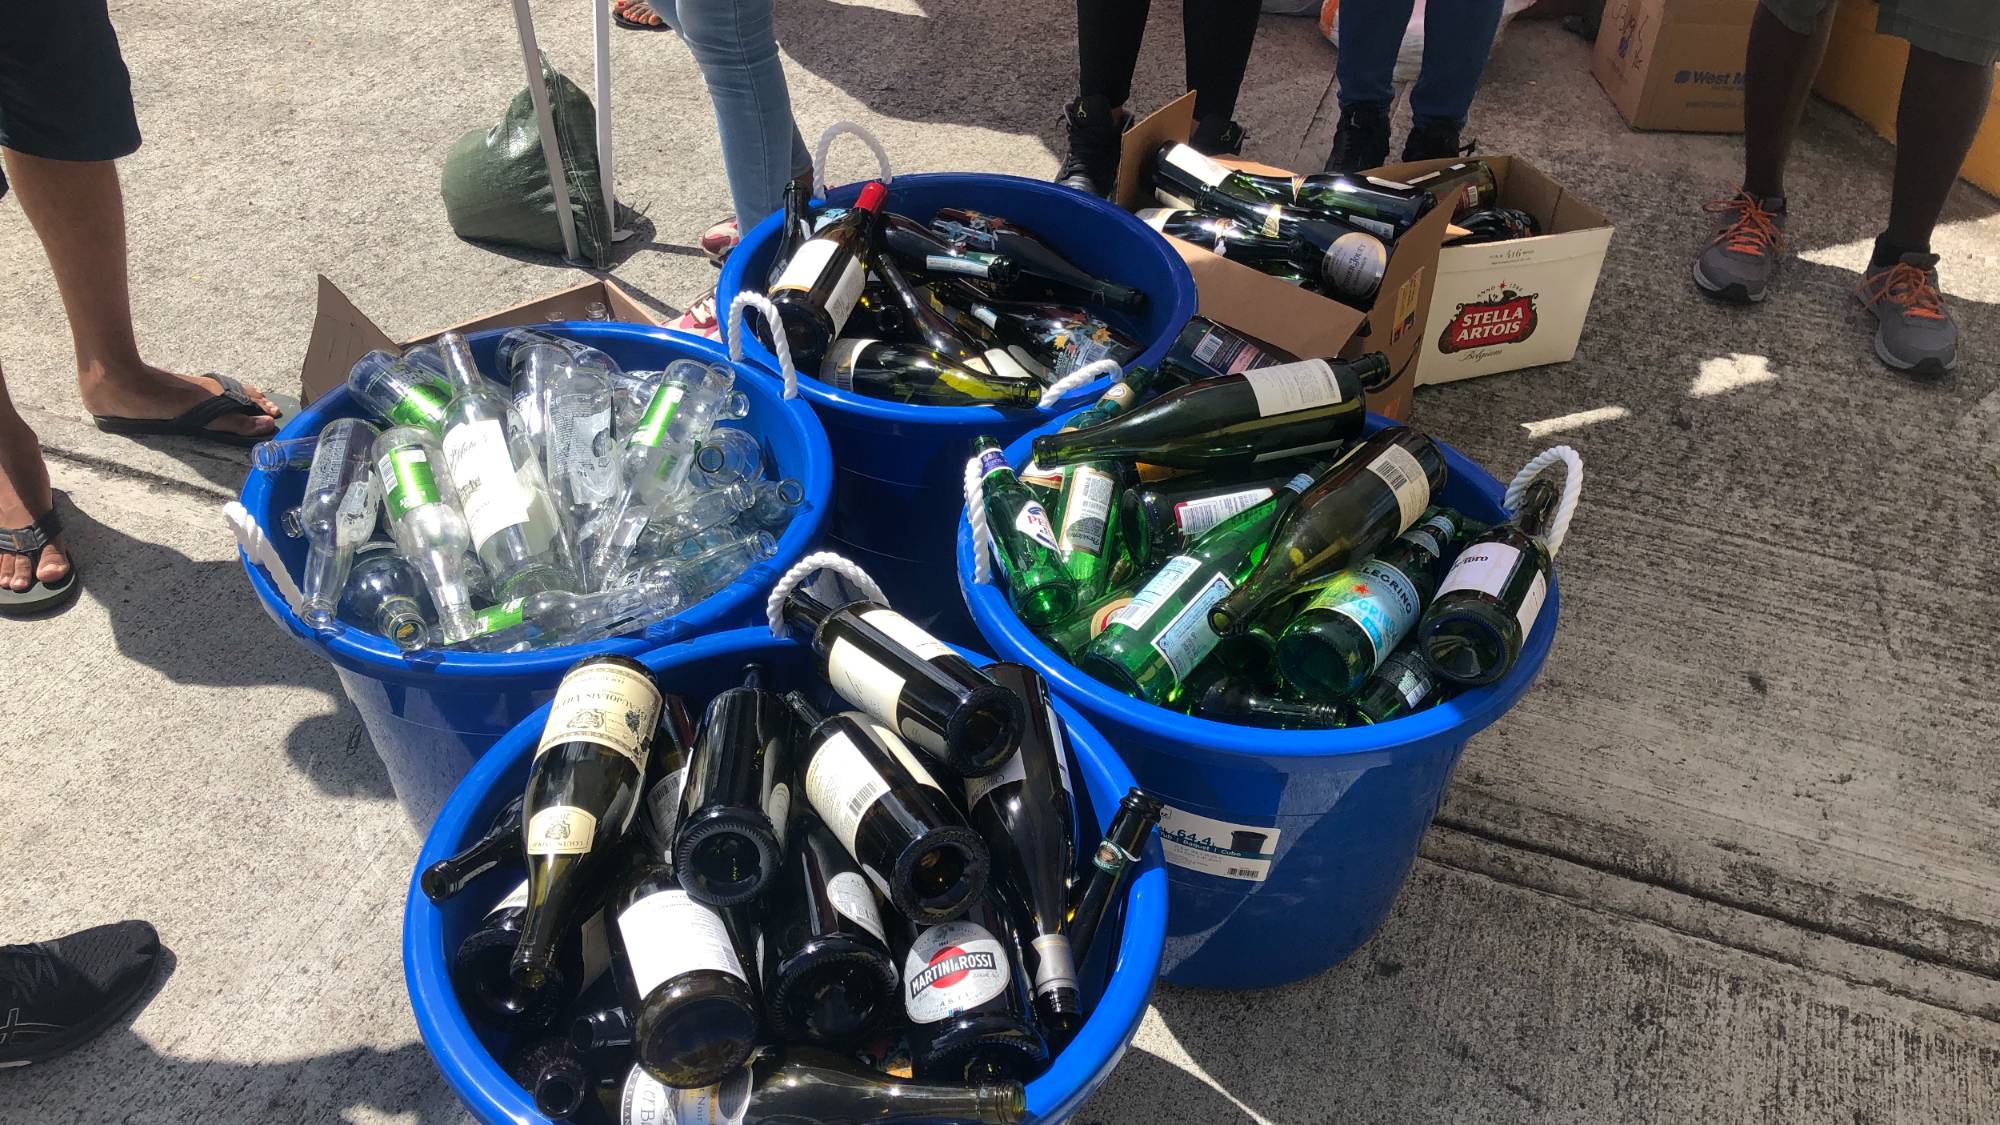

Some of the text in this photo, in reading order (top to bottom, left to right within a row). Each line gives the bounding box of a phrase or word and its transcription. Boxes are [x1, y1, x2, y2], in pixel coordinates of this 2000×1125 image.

[1694, 71, 1730, 85] West
[1462, 307, 1523, 327] STELLA
[1456, 321, 1521, 342] ARTOIS
[1362, 566, 1412, 615] LEGRINO
